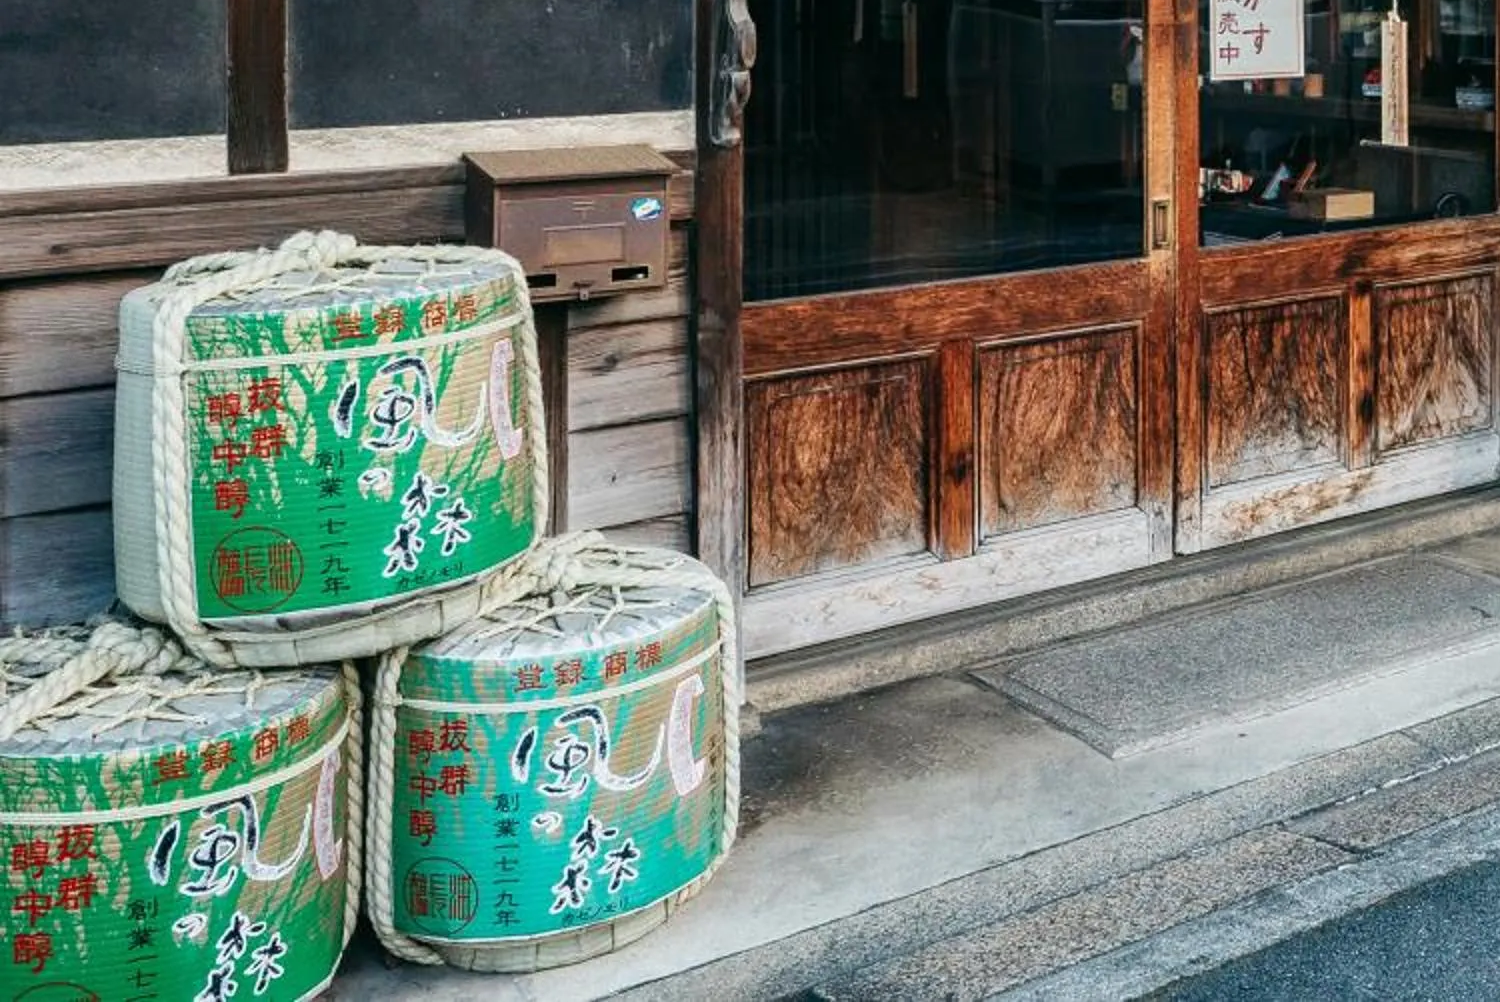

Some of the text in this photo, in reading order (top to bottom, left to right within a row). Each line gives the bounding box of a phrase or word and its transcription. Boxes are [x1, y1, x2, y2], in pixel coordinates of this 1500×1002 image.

[514, 641, 663, 692] 登録商標
[152, 715, 312, 785] 登録商標
